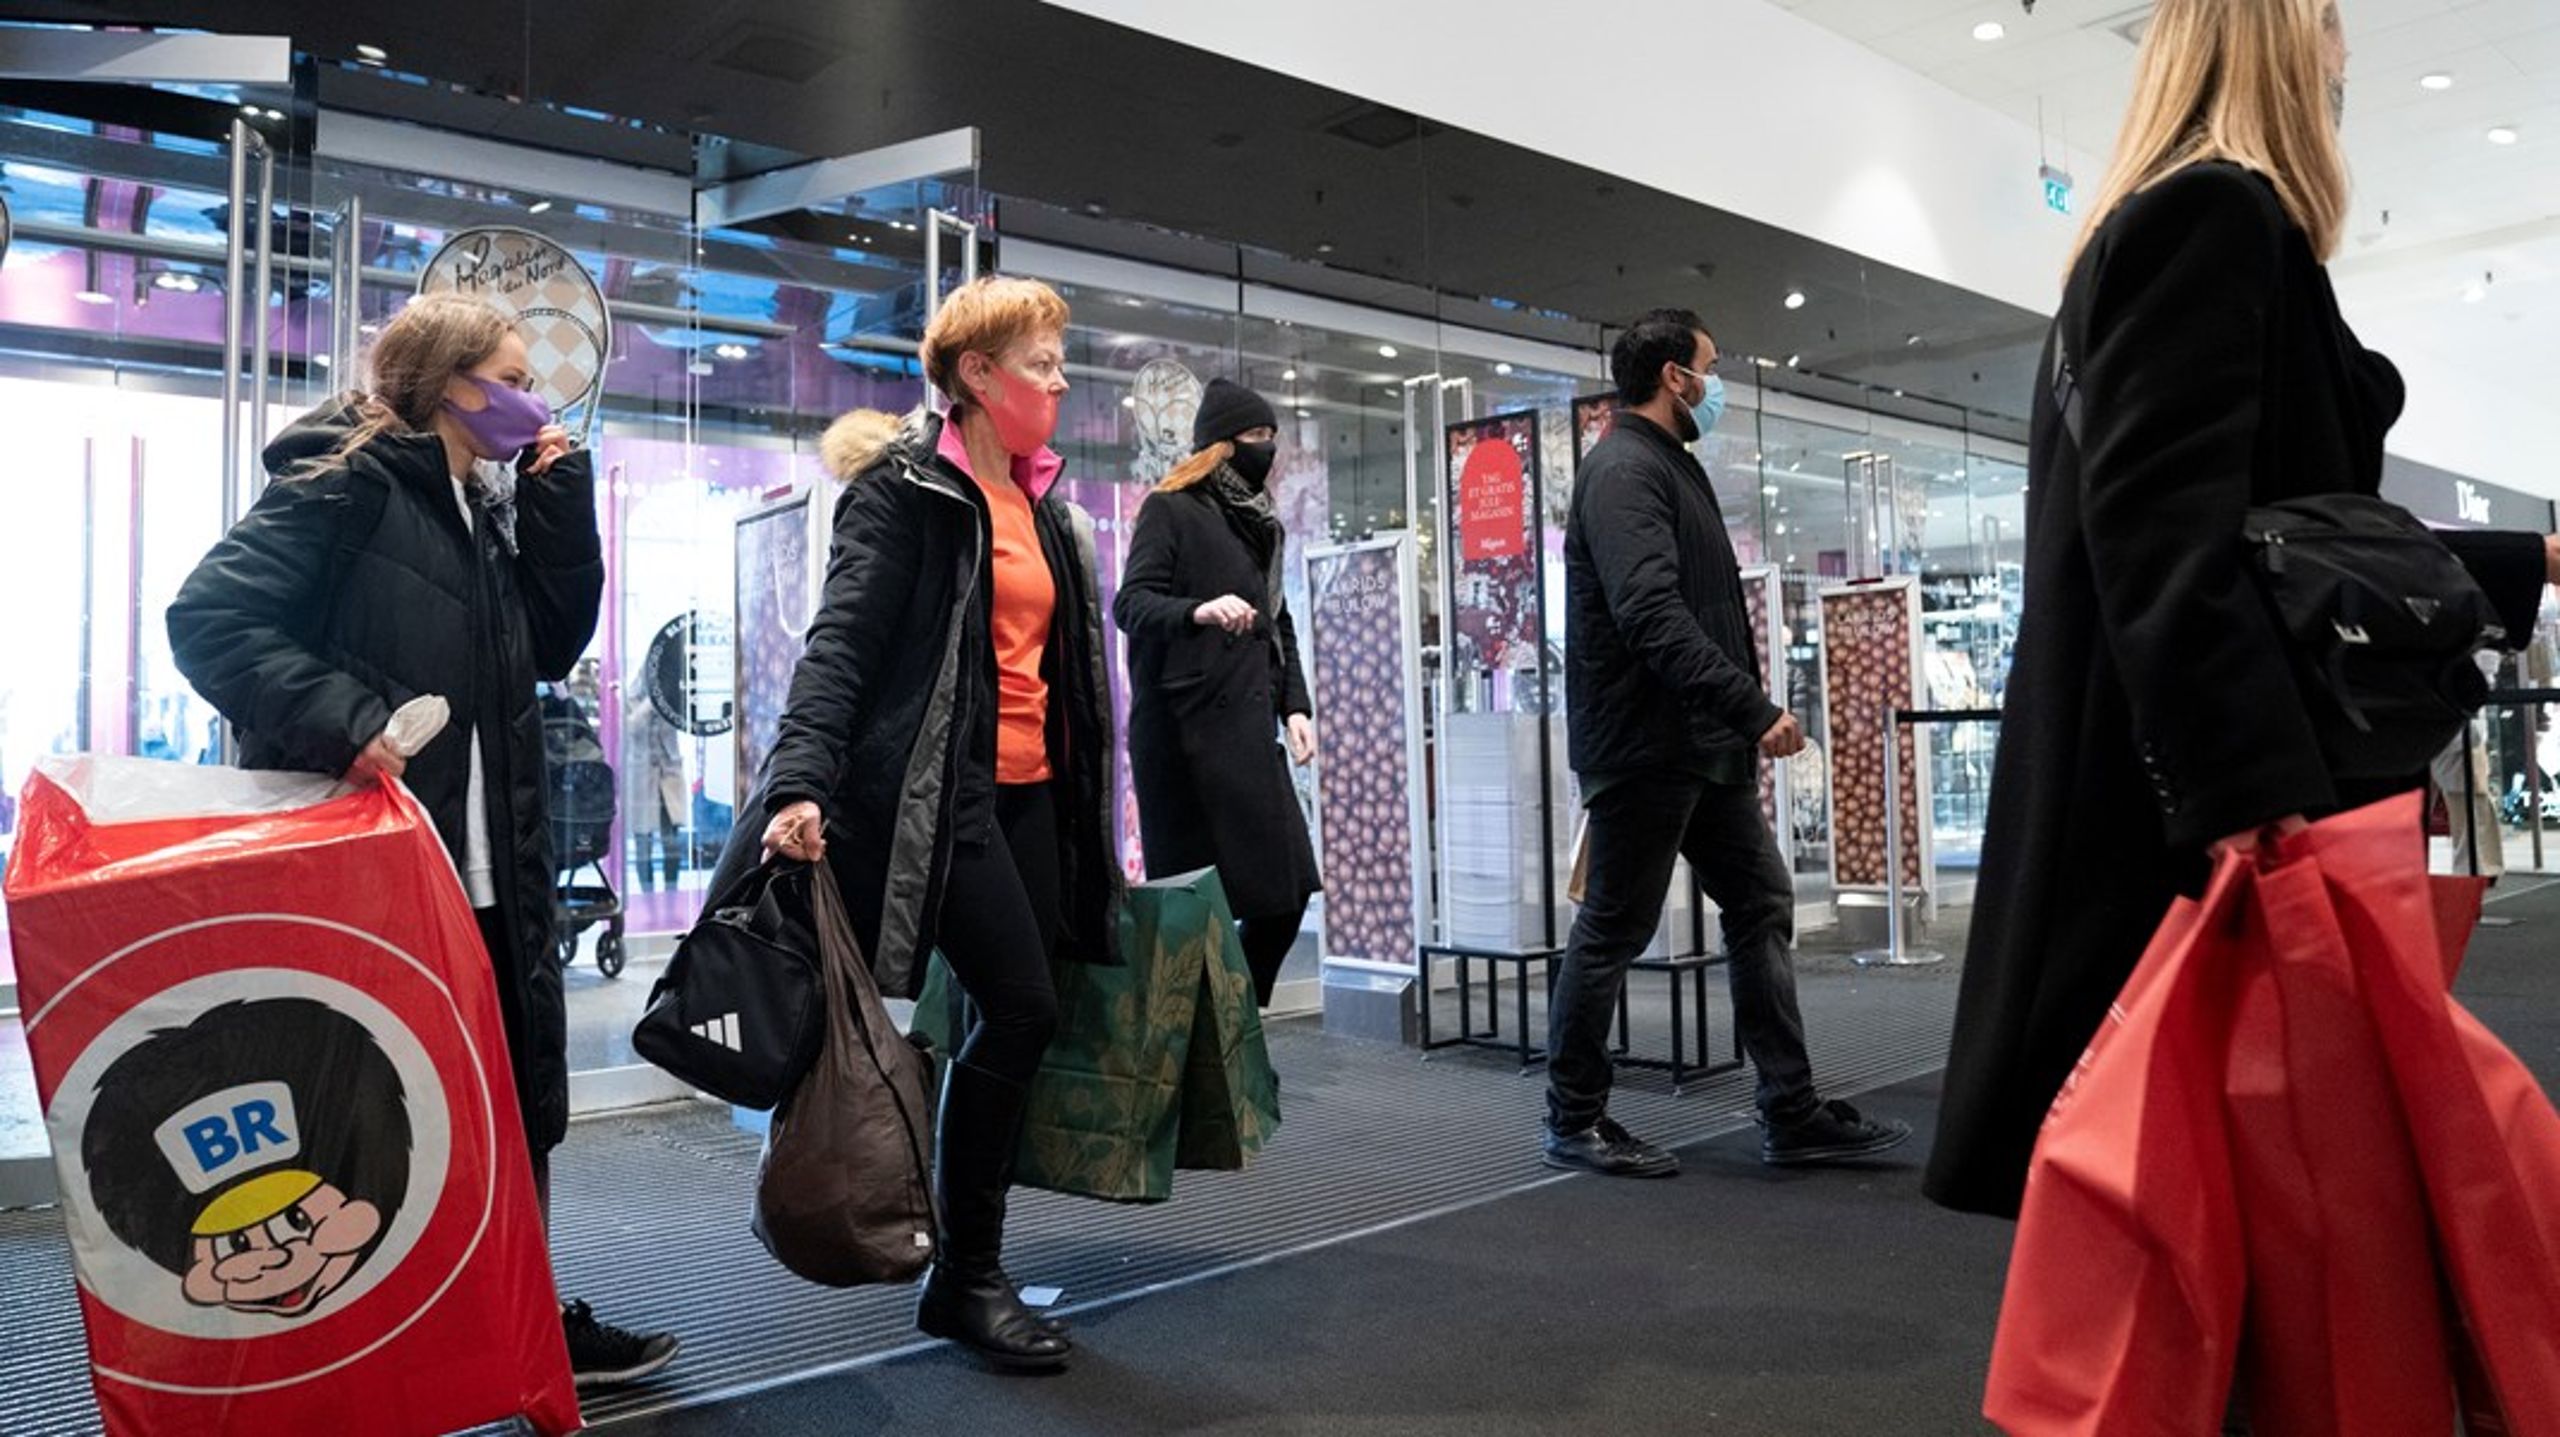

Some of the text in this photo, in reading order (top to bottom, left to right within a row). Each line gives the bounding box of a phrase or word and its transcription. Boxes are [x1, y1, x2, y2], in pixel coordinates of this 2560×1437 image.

[456, 235, 547, 293] Magasin
[526, 255, 566, 285] Nord
[182, 1099, 290, 1173] BR
